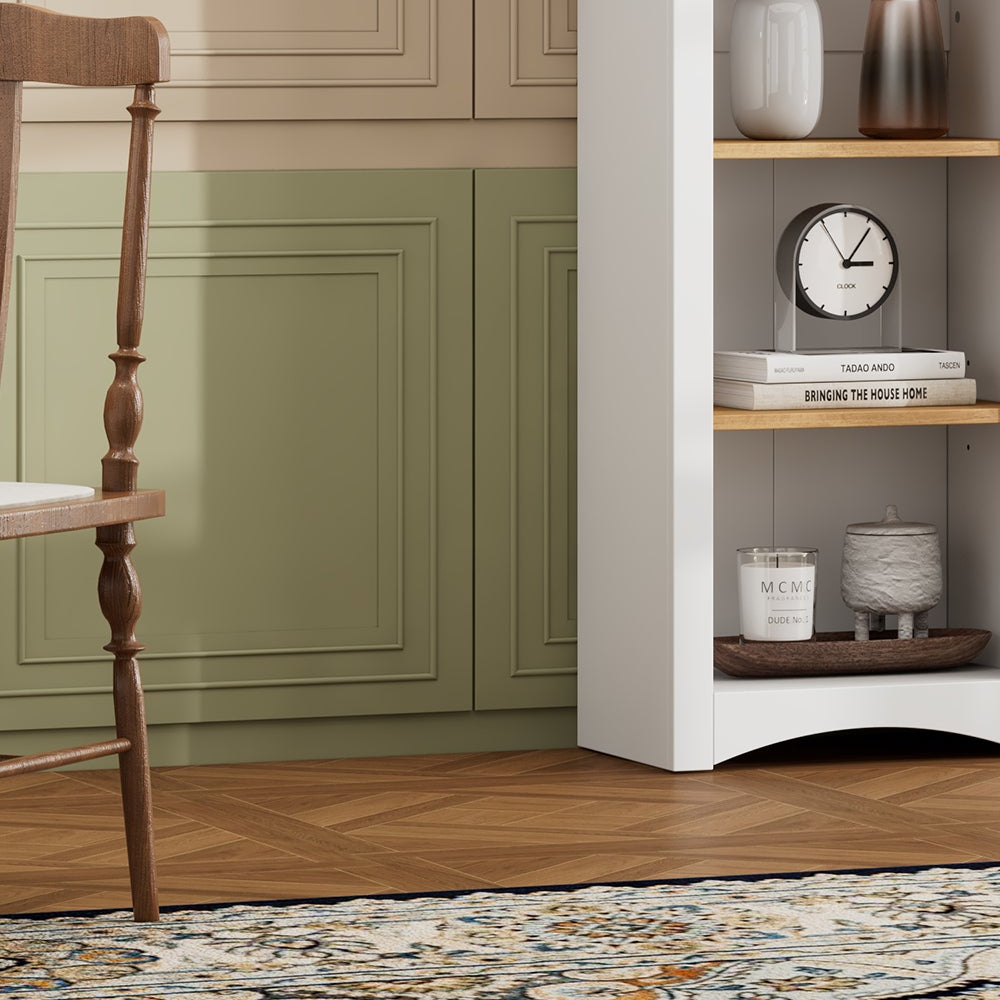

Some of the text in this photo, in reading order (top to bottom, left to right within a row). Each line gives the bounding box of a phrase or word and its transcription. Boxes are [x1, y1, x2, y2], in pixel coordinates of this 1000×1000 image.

[841, 364, 869, 373] TADAO
[871, 363, 895, 372] ANDO
[804, 387, 928, 402] BRINGING THE HOUSE HOME
[761, 579, 812, 593] MCMC
[768, 616, 790, 624] DUDE
